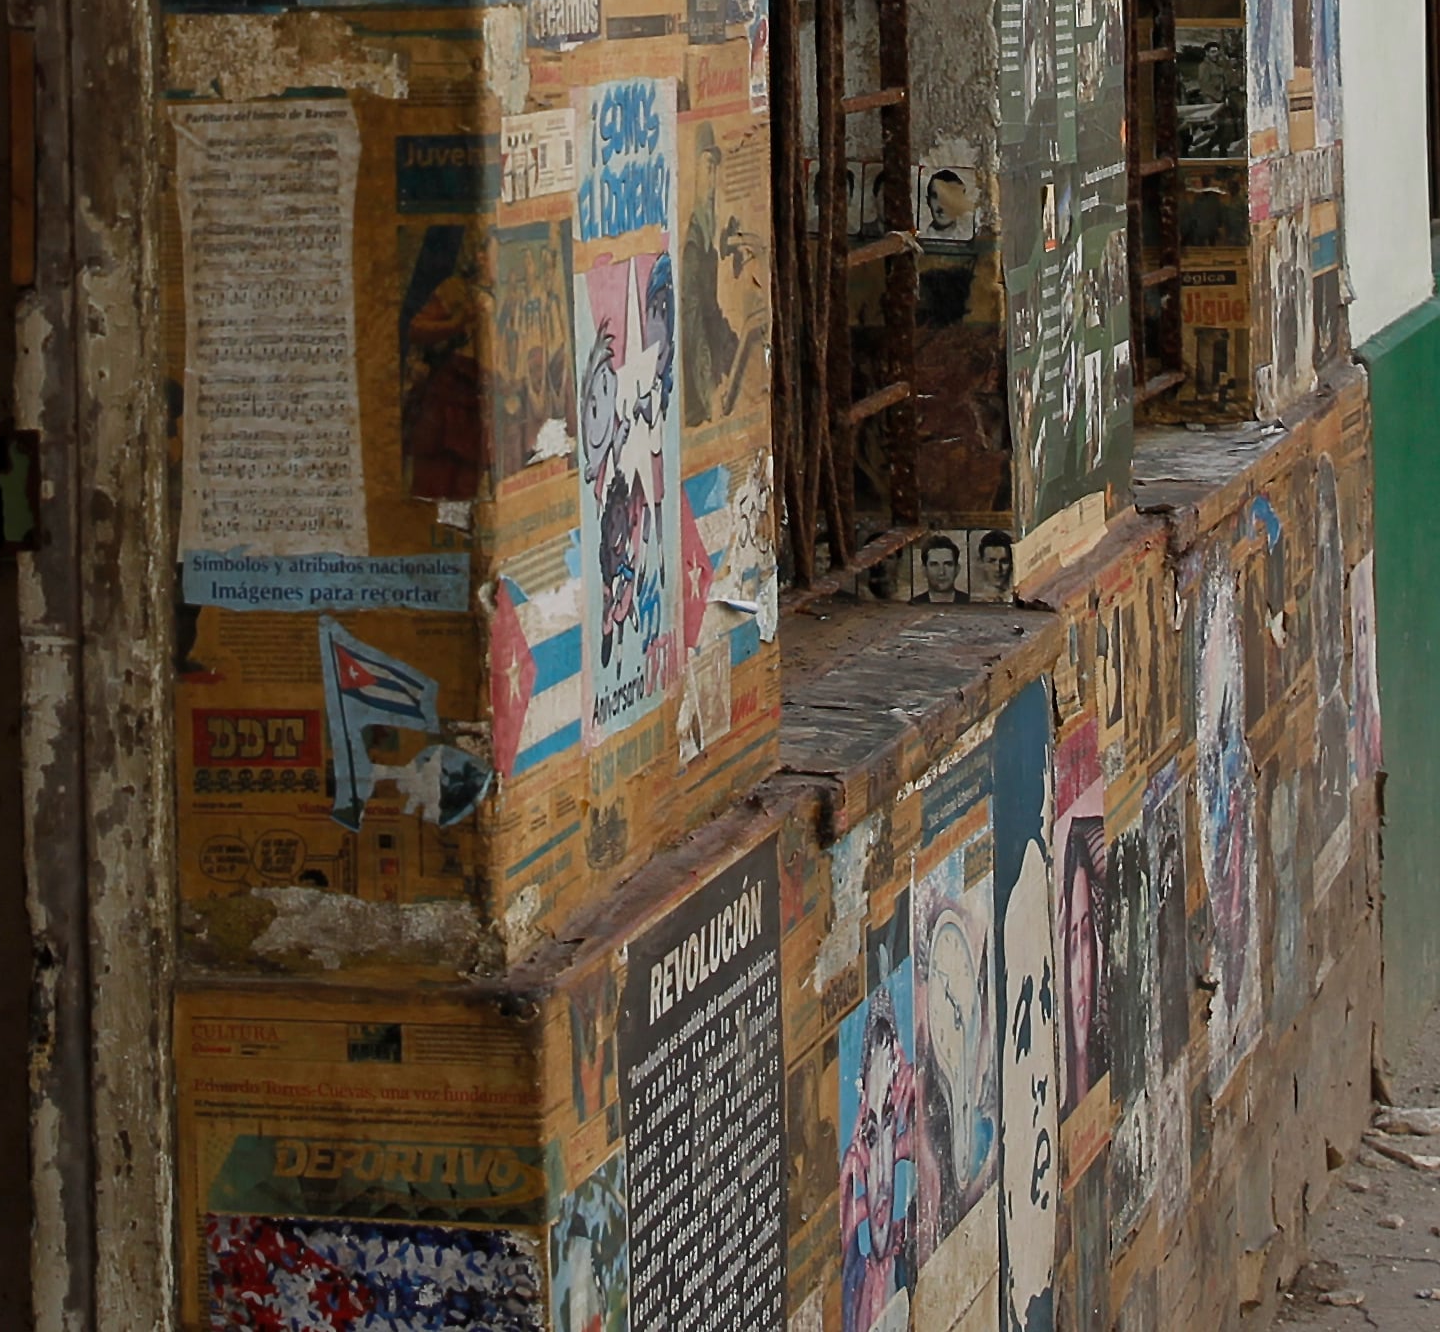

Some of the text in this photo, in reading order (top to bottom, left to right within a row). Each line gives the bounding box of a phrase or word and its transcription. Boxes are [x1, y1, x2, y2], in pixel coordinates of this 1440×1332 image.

[192, 554, 269, 574] Símbolos
[369, 555, 461, 576] nacionales
[211, 581, 440, 604] Imágenes para recortar
[205, 715, 306, 761] DDT
[648, 875, 762, 1027] REVOLUCIÓN
[191, 1023, 280, 1041] CULTURA
[192, 1076, 259, 1096] Eduardo
[380, 1087, 410, 1102] una
[272, 1138, 520, 1188] DEPORTIVO
